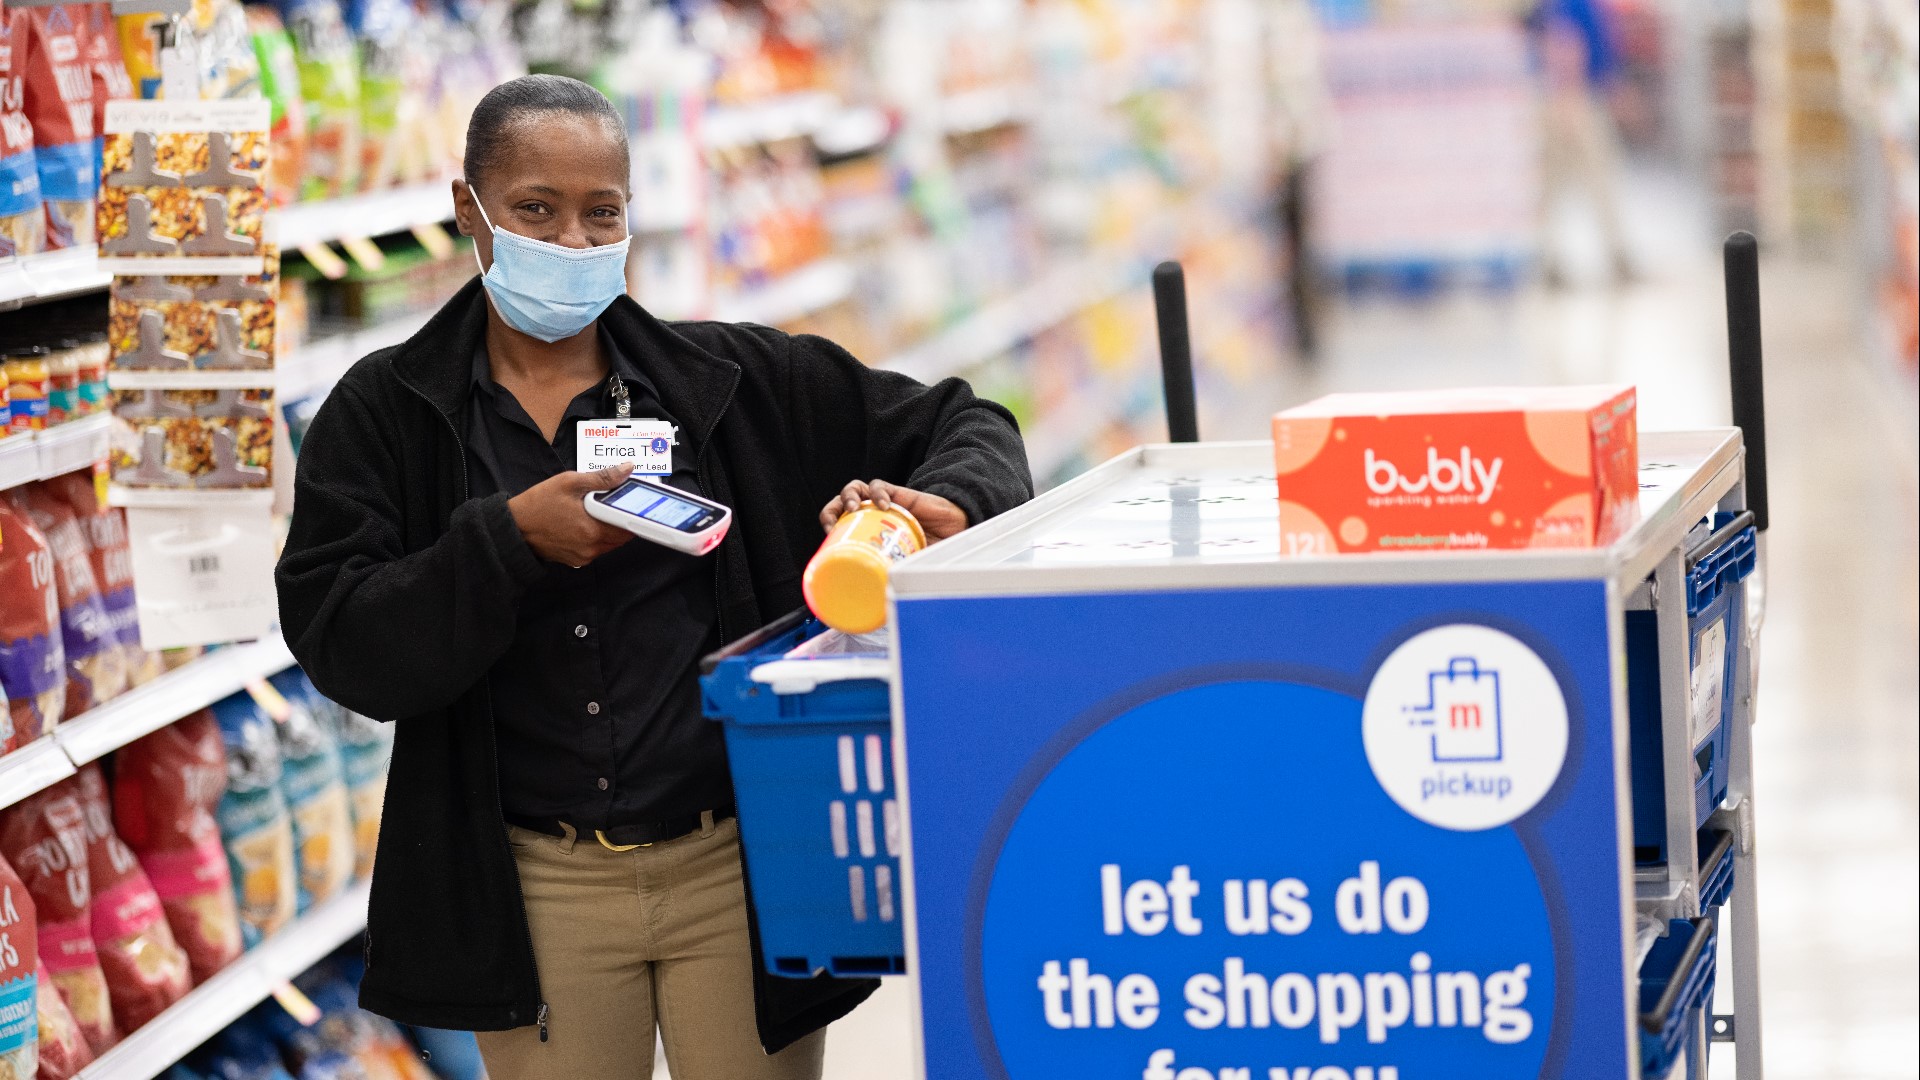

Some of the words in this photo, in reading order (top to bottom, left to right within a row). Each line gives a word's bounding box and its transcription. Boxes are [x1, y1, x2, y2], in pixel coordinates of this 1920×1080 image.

[584, 426, 620, 439] meijer
[656, 440, 662, 448] 1
[594, 444, 636, 457] Errica
[641, 444, 654, 457] T.
[646, 463, 667, 471] Lead
[1365, 446, 1502, 503] bubly
[1451, 705, 1480, 728] m
[1422, 773, 1511, 800] pickup
[1101, 864, 1202, 935] let
[1224, 878, 1311, 935] us
[1336, 861, 1428, 933] do
[1038, 958, 1159, 1028] the
[1185, 952, 1532, 1043] shopping
